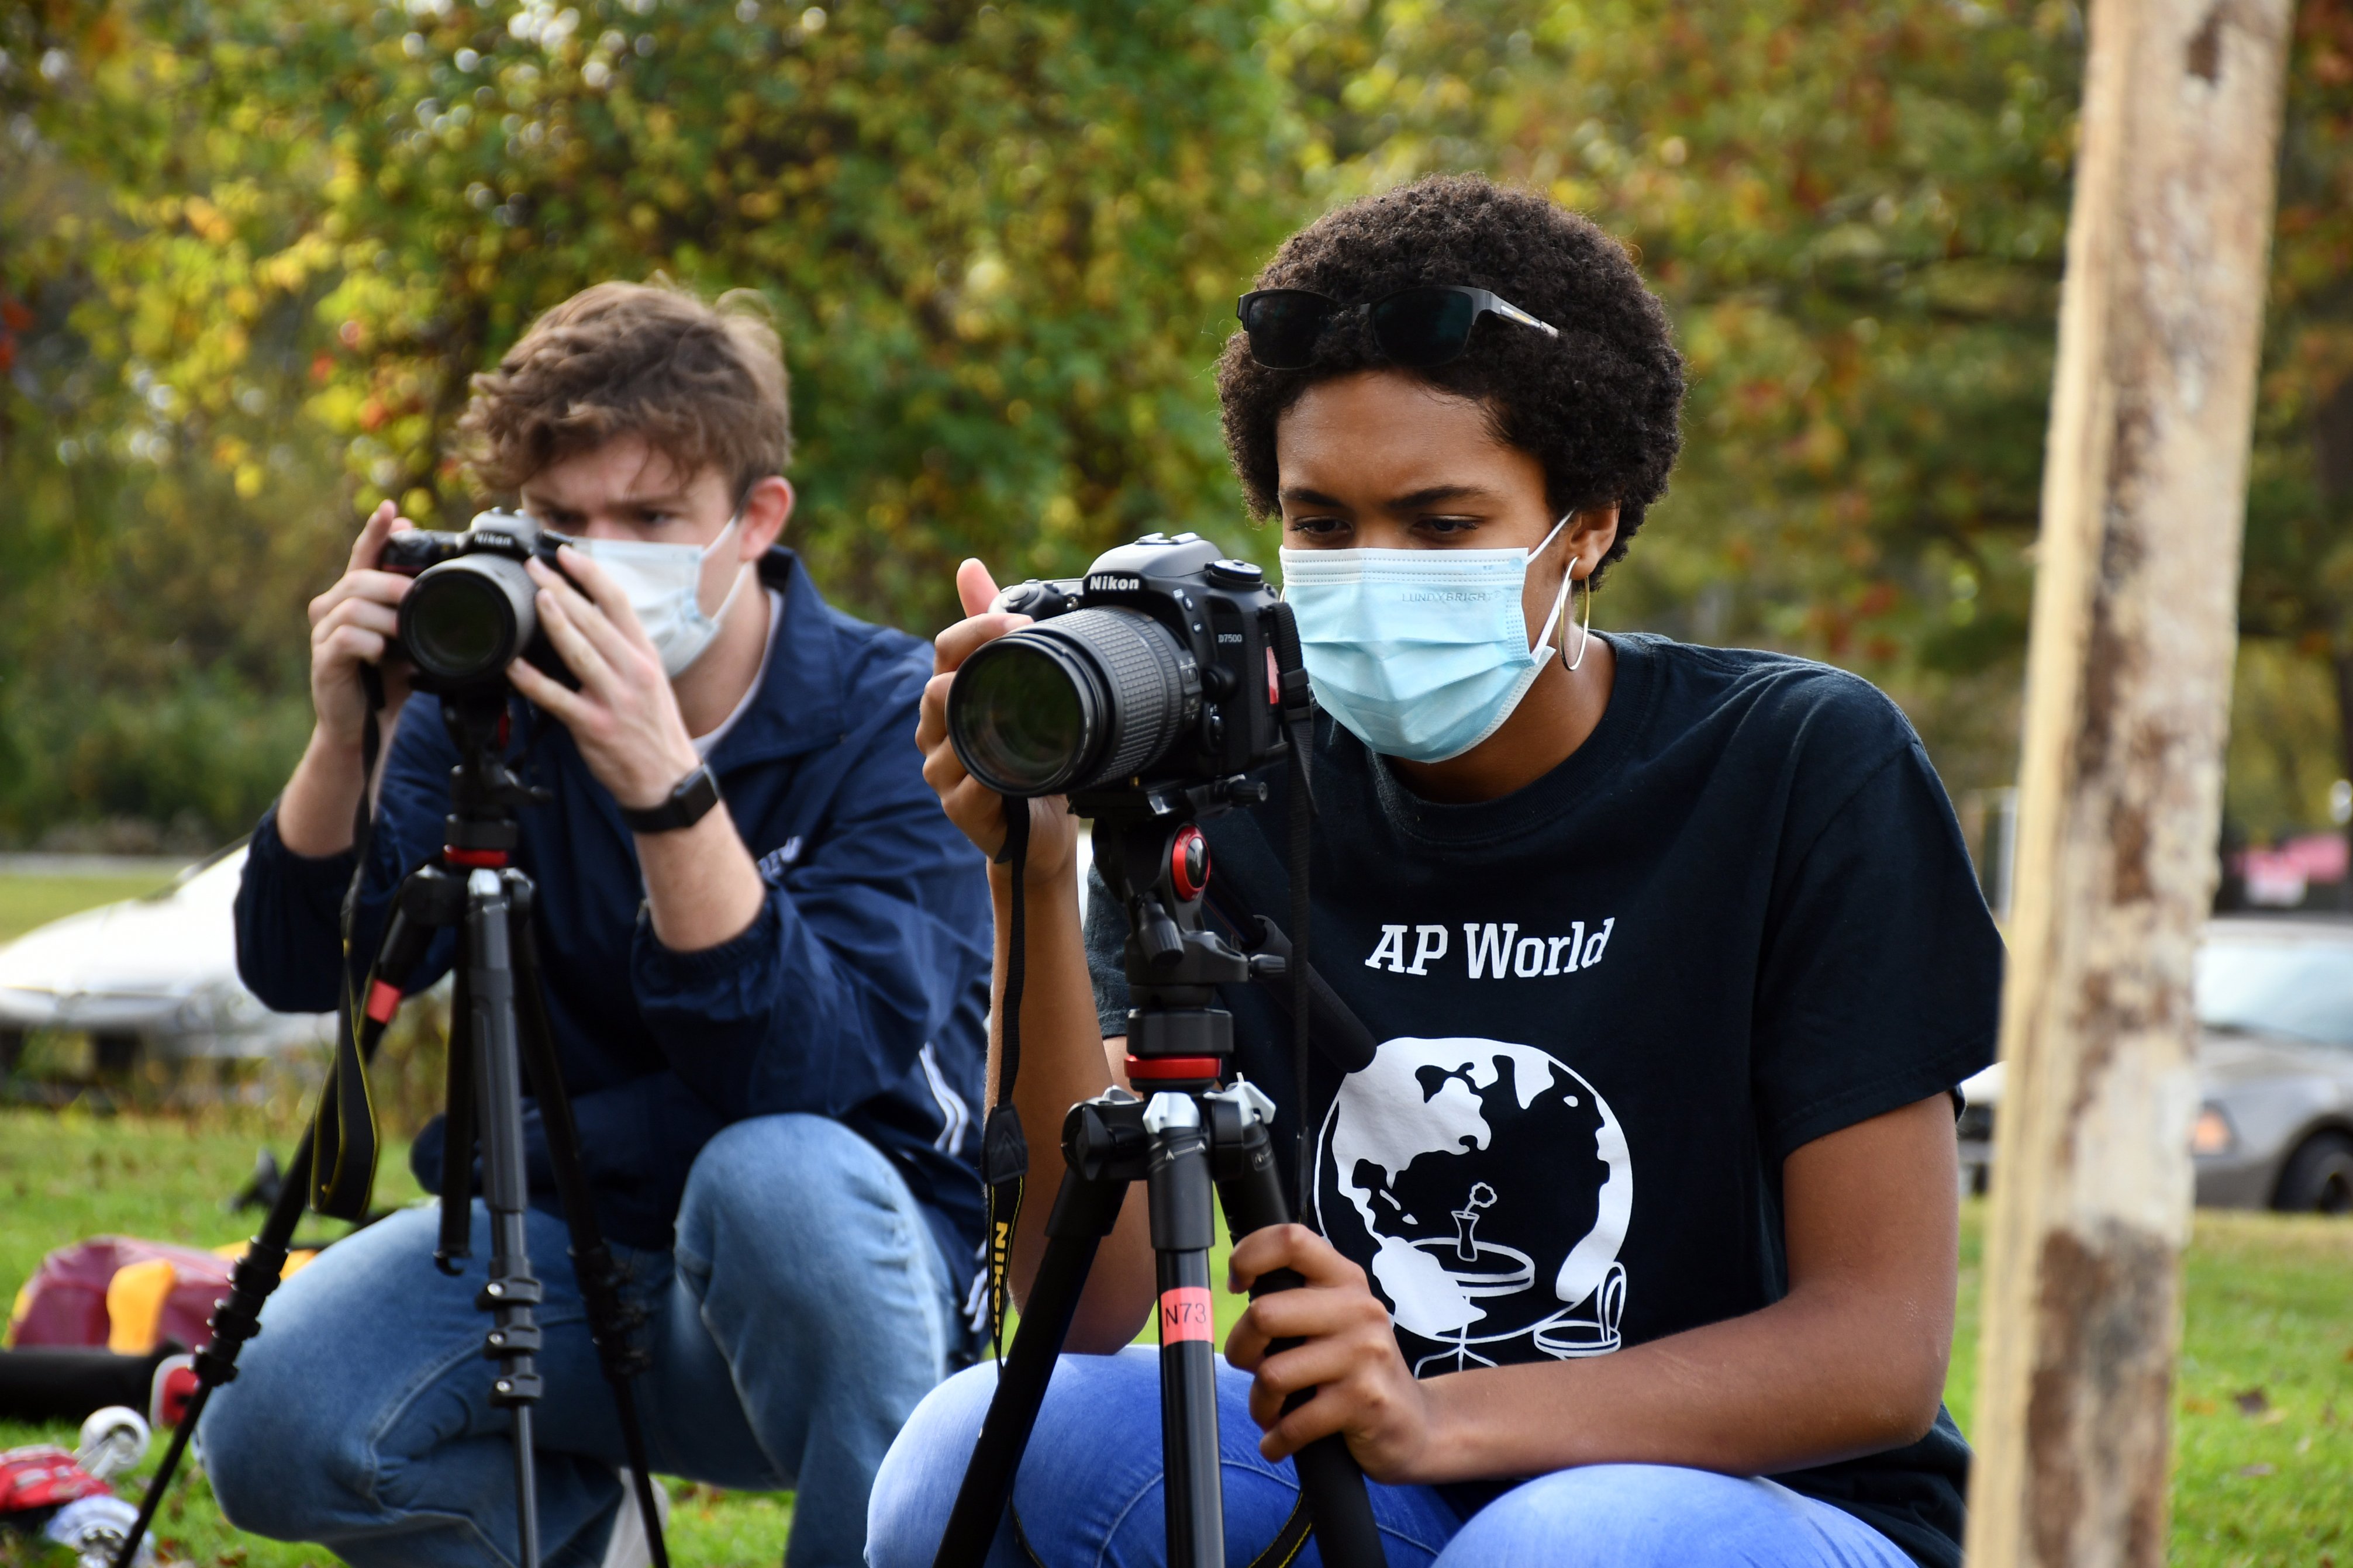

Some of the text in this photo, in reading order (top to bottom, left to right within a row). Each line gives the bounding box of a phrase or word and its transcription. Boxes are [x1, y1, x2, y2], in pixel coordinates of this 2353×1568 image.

[474, 533, 512, 546] Nikon
[1089, 575, 1140, 590] Nikon
[1218, 634, 1242, 643] D7500
[1365, 917, 1616, 979] AP World
[995, 1221, 1009, 1338] Nikon
[1165, 1303, 1206, 1328] N73
